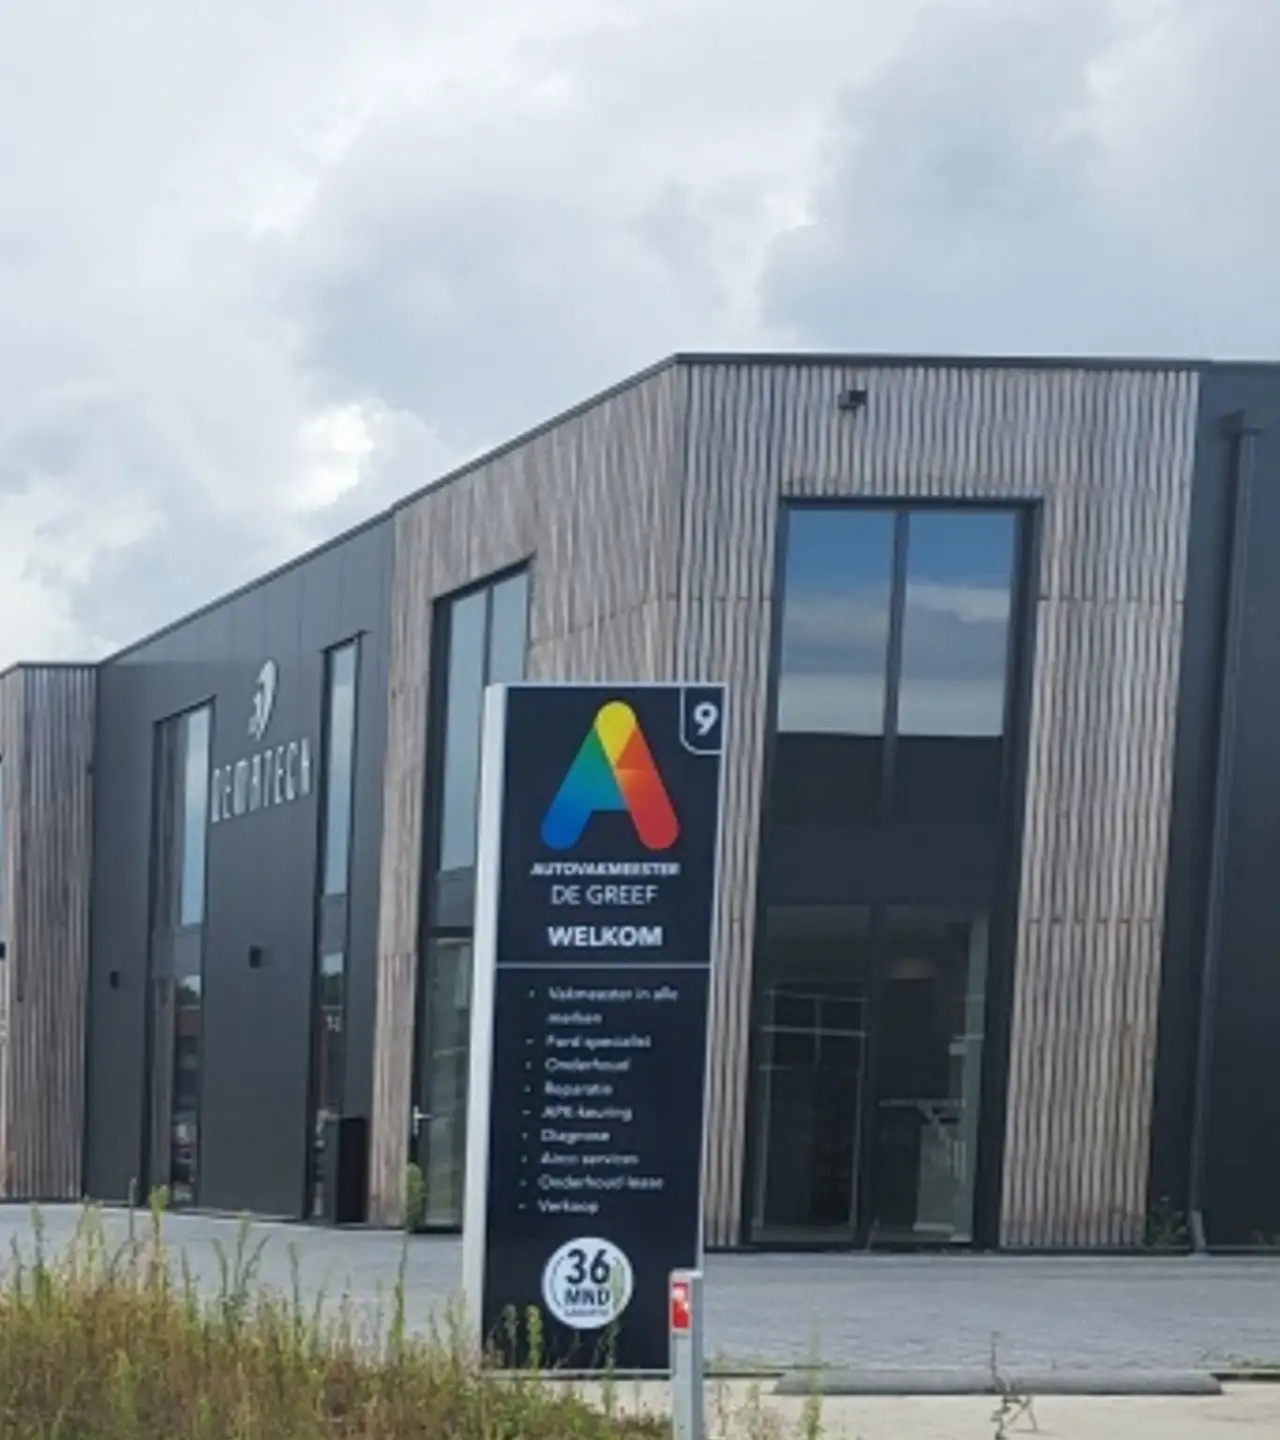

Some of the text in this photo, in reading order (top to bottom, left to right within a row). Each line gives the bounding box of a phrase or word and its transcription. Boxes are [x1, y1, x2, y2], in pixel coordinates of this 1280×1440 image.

[694, 702, 719, 735] 9
[530, 862, 681, 876] AUTOVAKMEESTER
[551, 885, 659, 905] DE GREEF
[547, 926, 664, 947] WELKOM
[544, 1057, 631, 1073] Onderhoud
[544, 1080, 614, 1097] Reparatie
[541, 1128, 611, 1145] Diagnose
[537, 1199, 600, 1216] Verkoop
[565, 1248, 611, 1285] 36
[564, 1289, 611, 1306] MND
